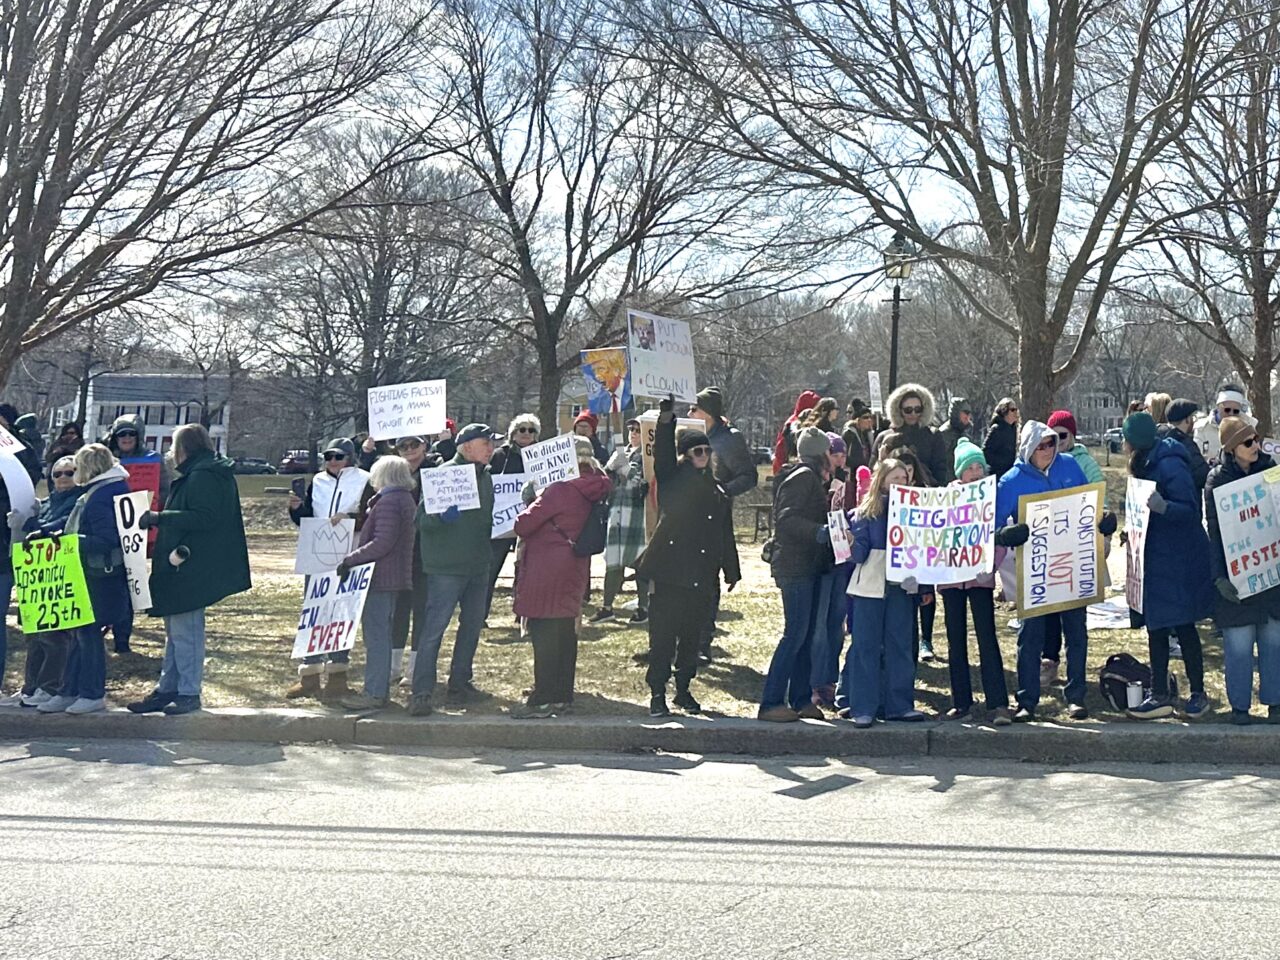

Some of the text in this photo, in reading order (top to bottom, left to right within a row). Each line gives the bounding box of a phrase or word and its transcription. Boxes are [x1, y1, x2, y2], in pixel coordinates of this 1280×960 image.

[369, 389, 409, 405] FIGHTING
[406, 416, 424, 426] ME
[524, 437, 571, 461] We ditched
[530, 453, 570, 473] our KING
[539, 468, 566, 486] in 1776
[897, 481, 986, 507] TRUMP IS
[1219, 484, 1267, 513] GRAB
[899, 501, 994, 529] REIGNING
[1239, 504, 1261, 523] HIM
[889, 525, 918, 547] ON
[1227, 536, 1252, 554] THE
[24, 542, 61, 565] STOP
[1030, 515, 1049, 606] SUGGESTION
[1047, 509, 1074, 593] ITS NOT
[1078, 504, 1095, 598] CONSTITUTION
[14, 563, 66, 591] Insanity
[310, 576, 331, 600] NO
[36, 600, 81, 631] 25th
[298, 605, 320, 630] IN
[307, 620, 354, 653] EVER!
